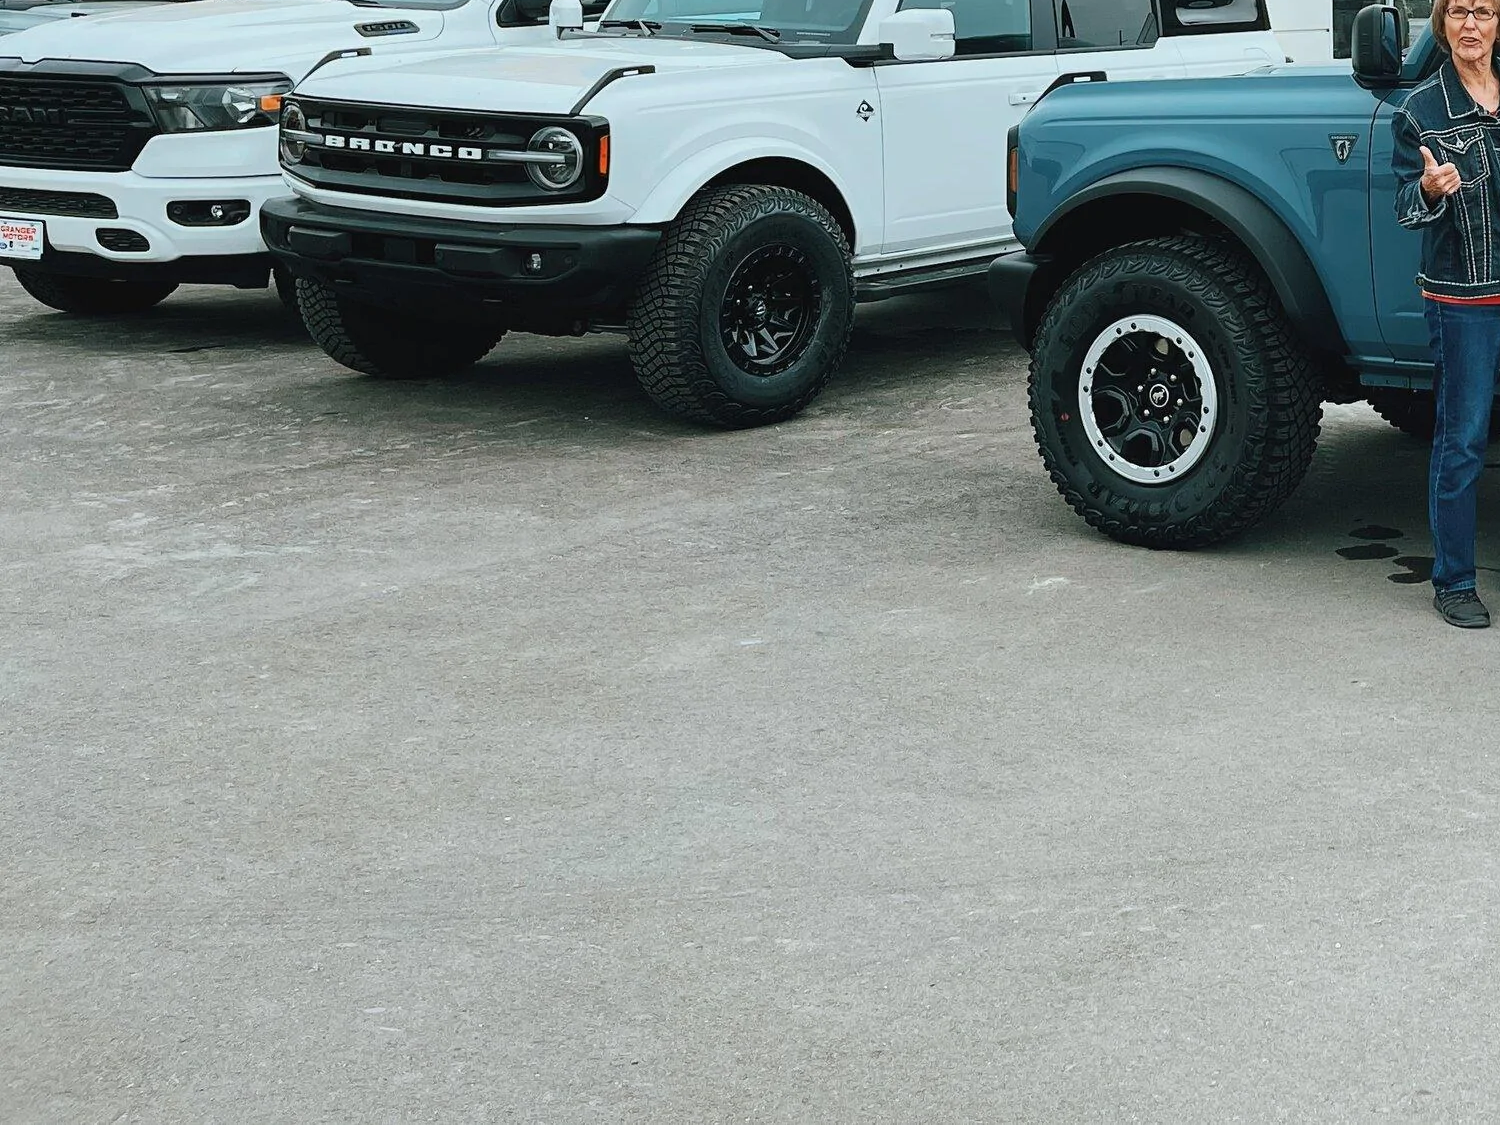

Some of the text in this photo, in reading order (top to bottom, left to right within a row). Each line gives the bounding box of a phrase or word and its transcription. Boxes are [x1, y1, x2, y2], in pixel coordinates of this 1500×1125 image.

[364, 22, 408, 32] 1500
[325, 134, 483, 160] BRONCO
[1, 225, 37, 235] GRANGER
[3, 233, 34, 242] MOTORS
